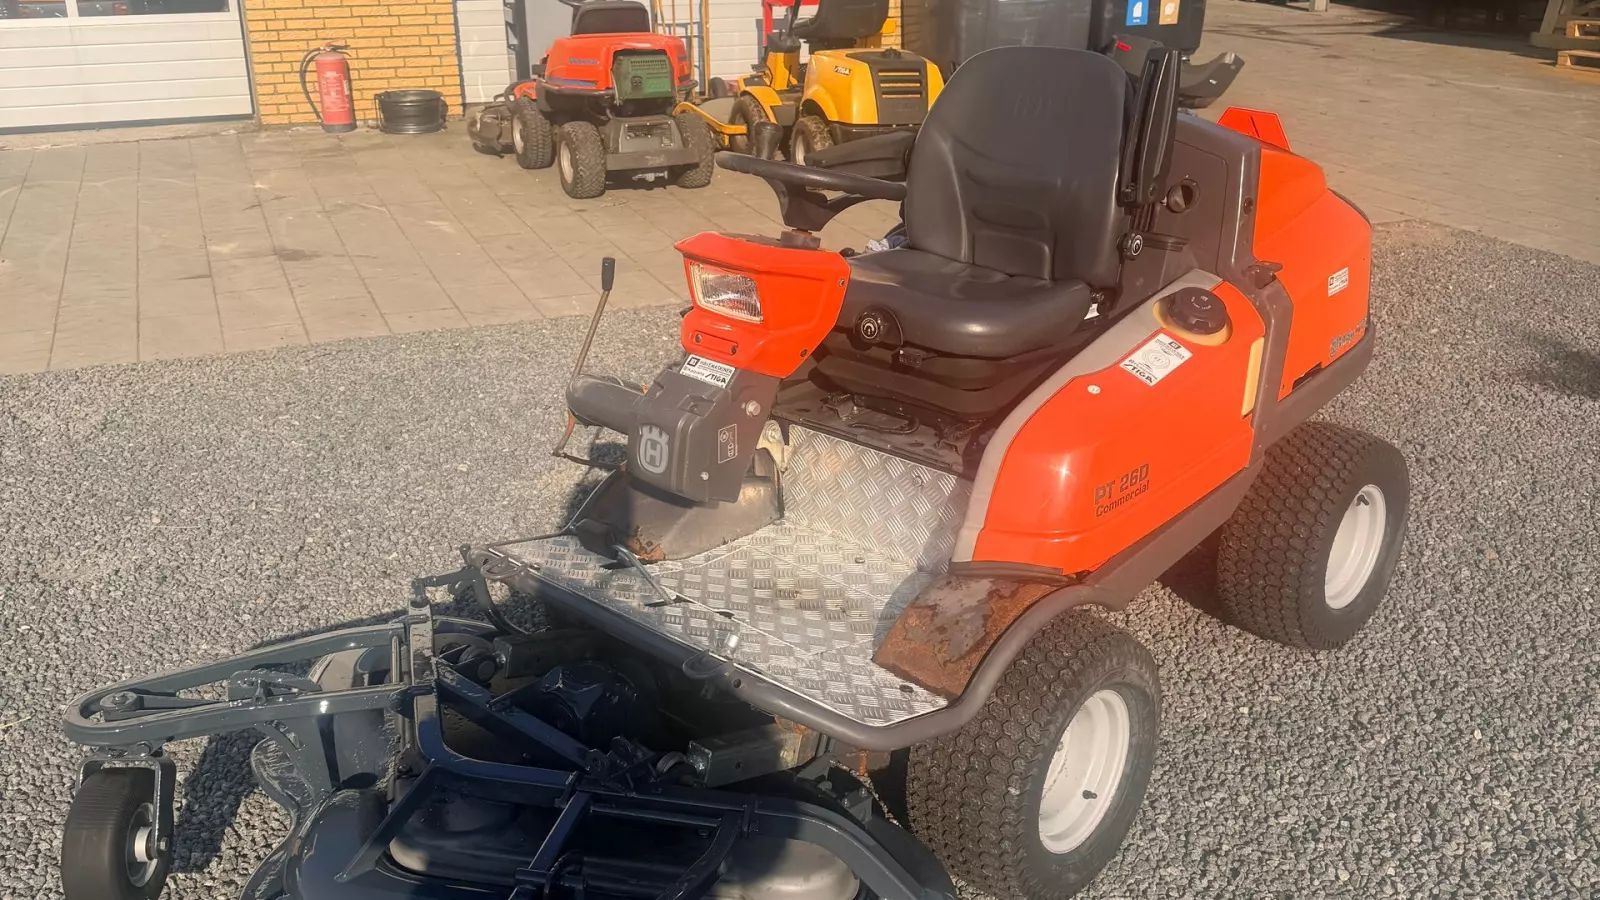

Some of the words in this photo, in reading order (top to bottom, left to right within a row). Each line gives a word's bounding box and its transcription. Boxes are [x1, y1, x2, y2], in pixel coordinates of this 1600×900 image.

[705, 373, 726, 384] STIGA
[1123, 363, 1153, 383] STIGA
[1095, 480, 1116, 505] PT
[1119, 463, 1149, 493] 26D
[1096, 480, 1149, 517] Commercial
